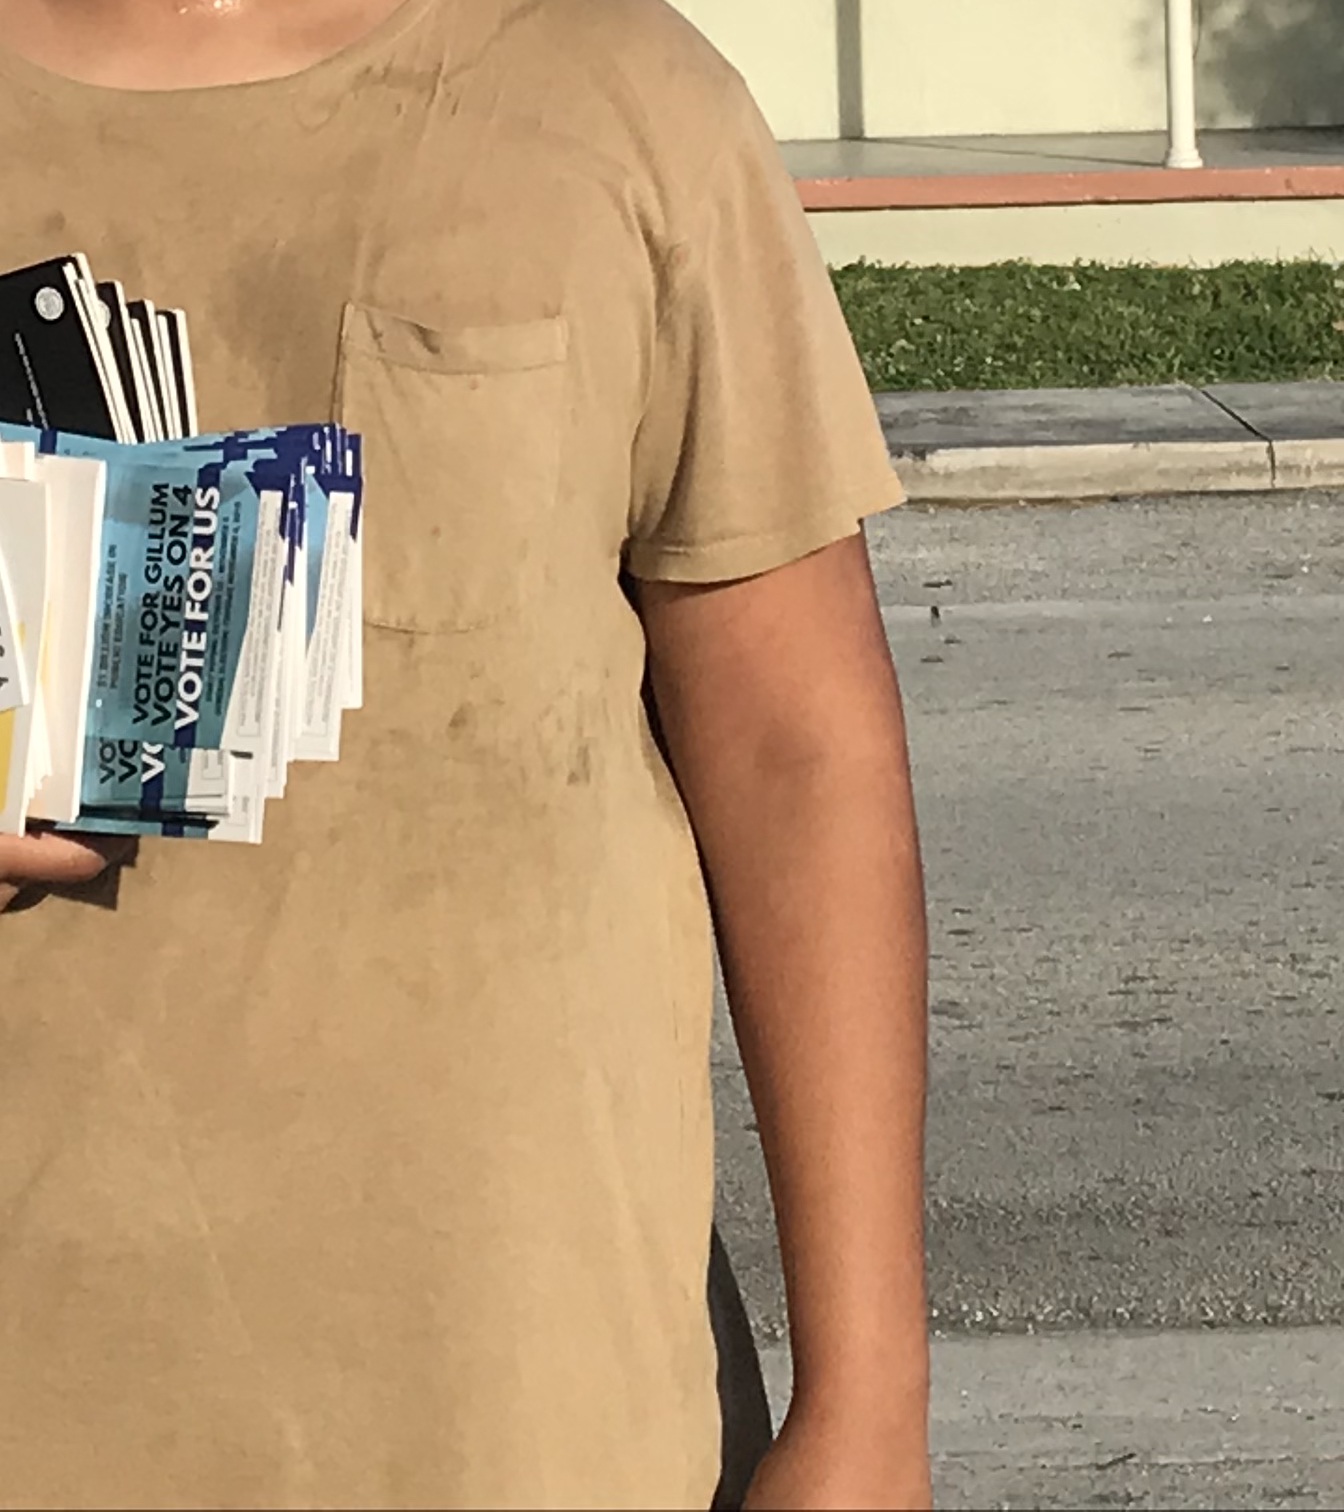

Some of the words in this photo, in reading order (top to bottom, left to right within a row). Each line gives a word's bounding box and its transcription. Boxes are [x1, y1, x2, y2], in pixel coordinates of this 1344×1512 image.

[171, 483, 192, 506] 4
[191, 484, 221, 537] US
[108, 544, 116, 558] IN
[143, 481, 169, 585] GILLUM
[165, 513, 189, 567] ON
[103, 560, 116, 620] INCREASE
[114, 572, 127, 642] EDUCATION
[159, 573, 184, 638] YES
[184, 544, 214, 622] FOR
[139, 588, 159, 646] FOR
[132, 652, 154, 726] VOTE
[150, 641, 177, 728] VOTE
[174, 629, 207, 733] VOTE
[99, 737, 117, 785] VO
[118, 740, 138, 785] VO
